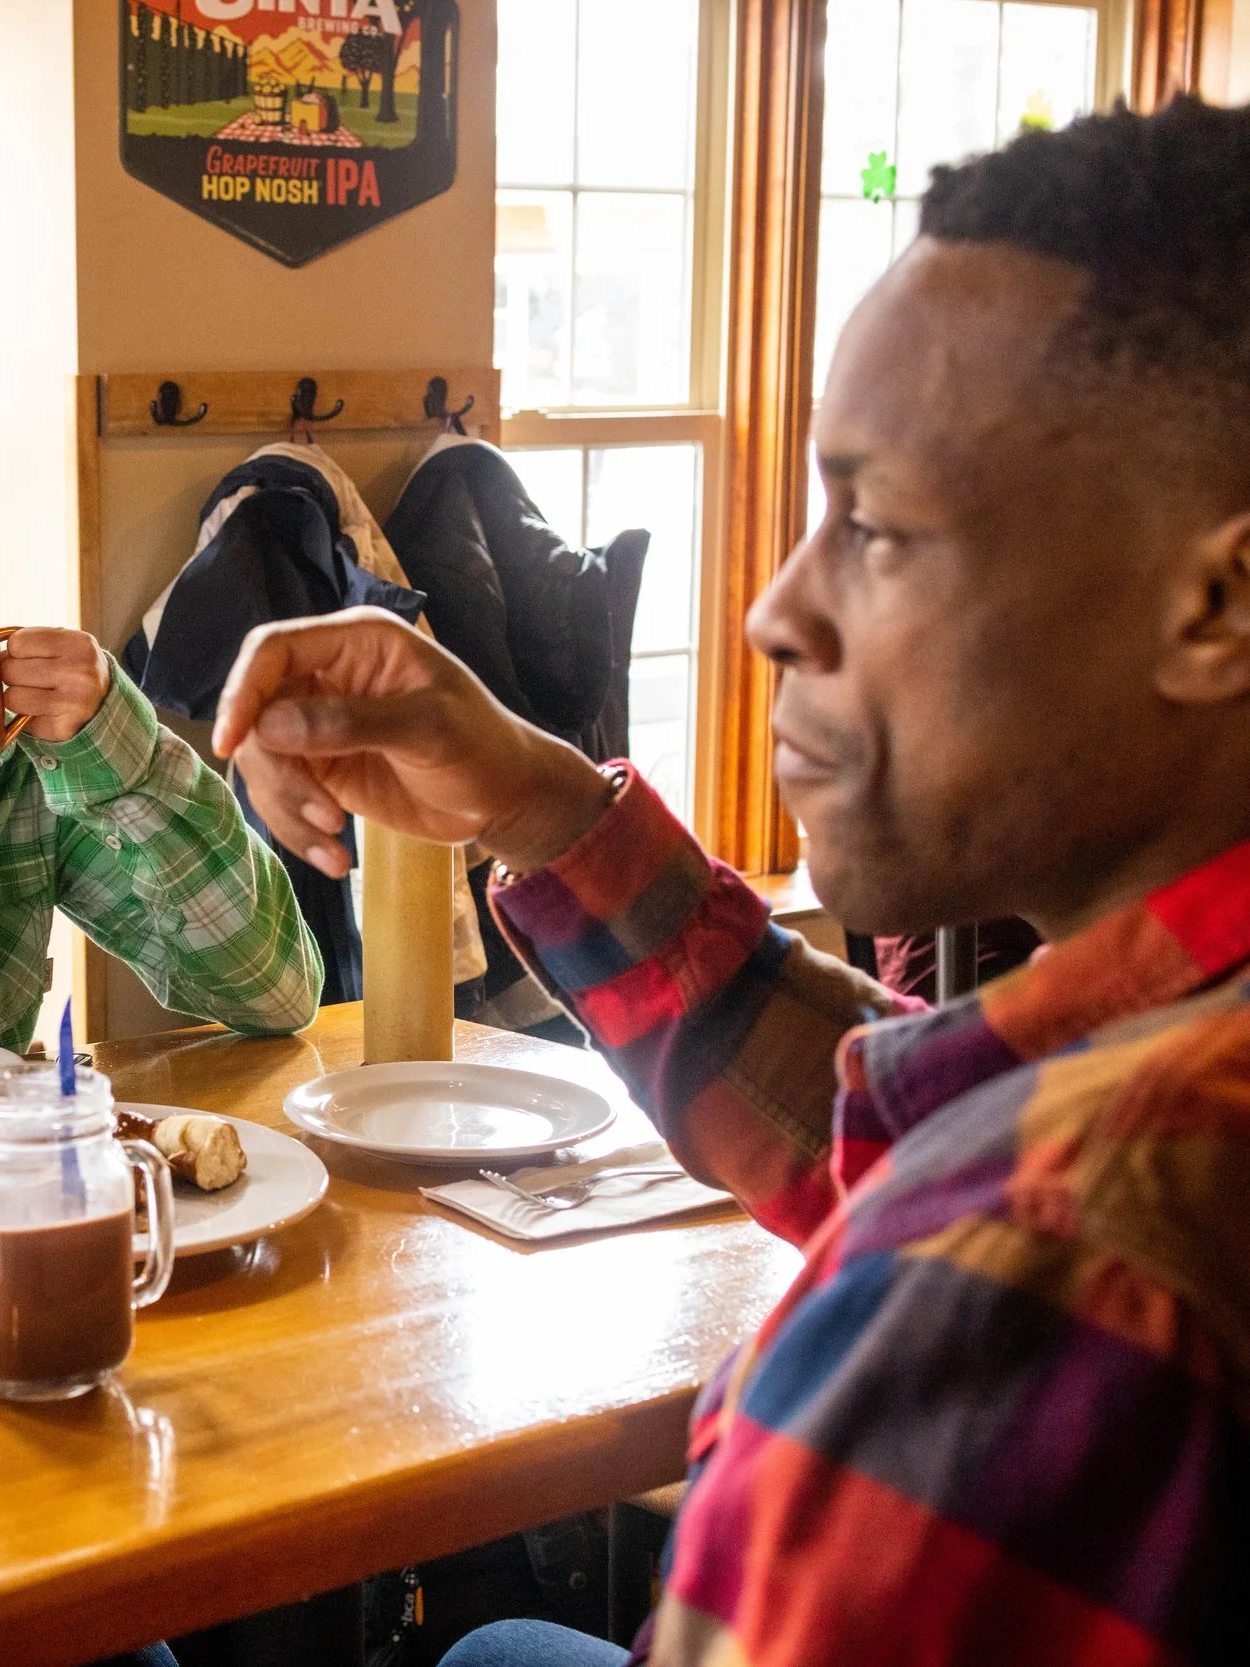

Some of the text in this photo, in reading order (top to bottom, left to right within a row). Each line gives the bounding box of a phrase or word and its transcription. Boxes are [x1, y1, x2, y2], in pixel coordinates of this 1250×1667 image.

[297, 16, 359, 33] BREWING
[205, 145, 320, 177] GRAPEFRUIT
[201, 174, 319, 204] HOP NOSH
[325, 158, 381, 207] IPA
